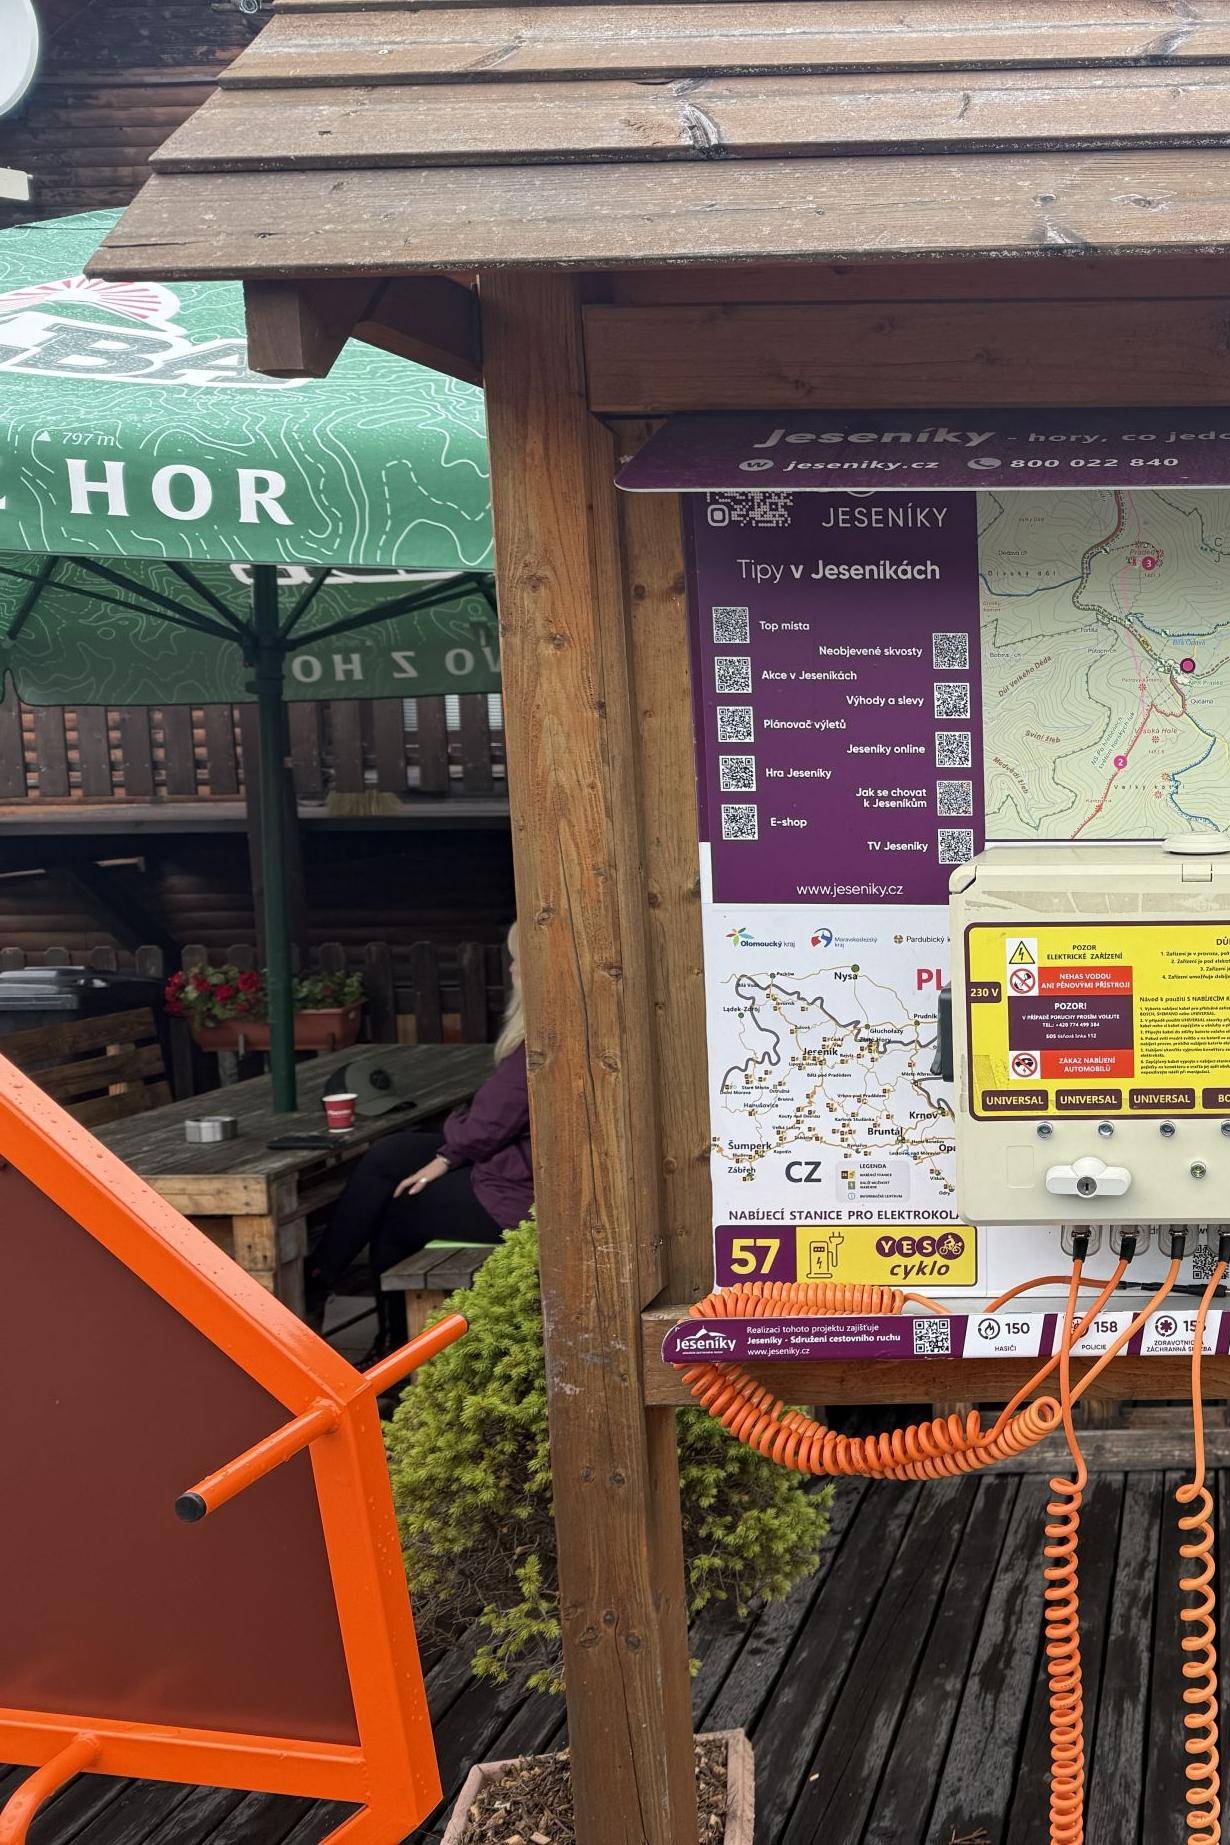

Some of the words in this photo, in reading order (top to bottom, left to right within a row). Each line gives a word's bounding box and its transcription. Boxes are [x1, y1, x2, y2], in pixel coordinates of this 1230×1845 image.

[62, 431, 98, 446] 797
[753, 427, 995, 450] Jeseníky
[1028, 430, 1108, 446] hory,
[1121, 431, 1158, 443] co
[783, 458, 940, 473] jeseniky.cz
[1009, 457, 1061, 469] 800
[1070, 457, 1120, 468] 022
[1129, 457, 1179, 468] 840
[64, 459, 294, 526] HOR
[821, 503, 949, 528] JESENÍKY
[737, 559, 785, 584] Tipy
[789, 564, 804, 580] v
[810, 559, 941, 581] Jeseníkách
[759, 620, 780, 633] Top
[781, 620, 810, 632] místa
[819, 645, 882, 660] Neobjevené
[883, 645, 923, 660] skvosty
[761, 670, 788, 681] Akce
[798, 669, 858, 681] Jeseníkách
[845, 694, 887, 708] Výhody
[897, 695, 925, 708] slevy
[763, 718, 812, 731] Plánovač
[813, 718, 847, 732] výletů
[846, 743, 892, 757] Jeseníky
[894, 743, 926, 755] online
[765, 768, 785, 779] Hra
[787, 767, 832, 780] Jeseníky
[855, 787, 875, 799] Jak
[876, 789, 889, 799] se
[890, 787, 928, 799] chovat
[871, 797, 928, 809] Jeseníkům
[769, 817, 808, 829] E-shop
[866, 841, 881, 852] TV
[883, 840, 929, 854] Jeseníky
[796, 883, 904, 898] www.jeseniky.cz
[740, 940, 783, 950] Olomoucký
[783, 940, 796, 949] kraj
[834, 942, 845, 950] kraj
[905, 935, 945, 945] Pardubický
[1072, 943, 1097, 952] POZOR
[1046, 952, 1087, 961] ELEKTRICKÉ
[1090, 951, 1123, 960] ZAŘÍZENÍ
[833, 971, 858, 982] Nysa
[1059, 972, 1084, 981] NEHAS
[1085, 972, 1112, 981] VODOU
[970, 988, 989, 998] 230
[990, 987, 999, 998] V
[1054, 1002, 1088, 1012] POZOR!
[1058, 1055, 1082, 1065] ZÁKAZ
[1083, 1055, 1116, 1065] NABÍJENÍ
[1063, 1064, 1112, 1074] AUTOMOBILŮ
[986, 1096, 1044, 1105] UNIVERSAL
[1060, 1095, 1118, 1104] UNIVERSAL
[1133, 1094, 1191, 1104] UNIVERSAL
[743, 1102, 779, 1110] Hanušovice
[909, 1111, 938, 1120] Krnov
[867, 1126, 904, 1137] Bruntál
[727, 1139, 773, 1151] Šumperk
[727, 1166, 757, 1175] Zábřeh
[784, 1160, 823, 1184] CZ
[728, 1207, 785, 1222] NABÍJECÍ
[789, 1210, 843, 1221] STANICE
[847, 1209, 874, 1220] PRO
[880, 1240, 934, 1255] YES
[730, 1238, 781, 1275] 57
[889, 1260, 951, 1280] cyklo
[746, 1323, 781, 1334] Realizaci
[782, 1323, 810, 1333] tohoto
[811, 1323, 846, 1335] projektu
[846, 1322, 880, 1334] zajišťuje
[1004, 1321, 1031, 1335] 150
[1093, 1320, 1119, 1334] 158
[675, 1336, 737, 1353] Jeseníky
[747, 1335, 783, 1346] Jeseníky
[790, 1334, 828, 1345] Sdružení
[829, 1333, 875, 1344] cestovního
[876, 1333, 901, 1343] ruchu
[747, 1346, 810, 1357] www.jeseniky.cz
[994, 1344, 1017, 1352] HASIČI
[1081, 1343, 1107, 1352] POLICIE
[1146, 1343, 1187, 1354] ZÁCHRANNÁ
